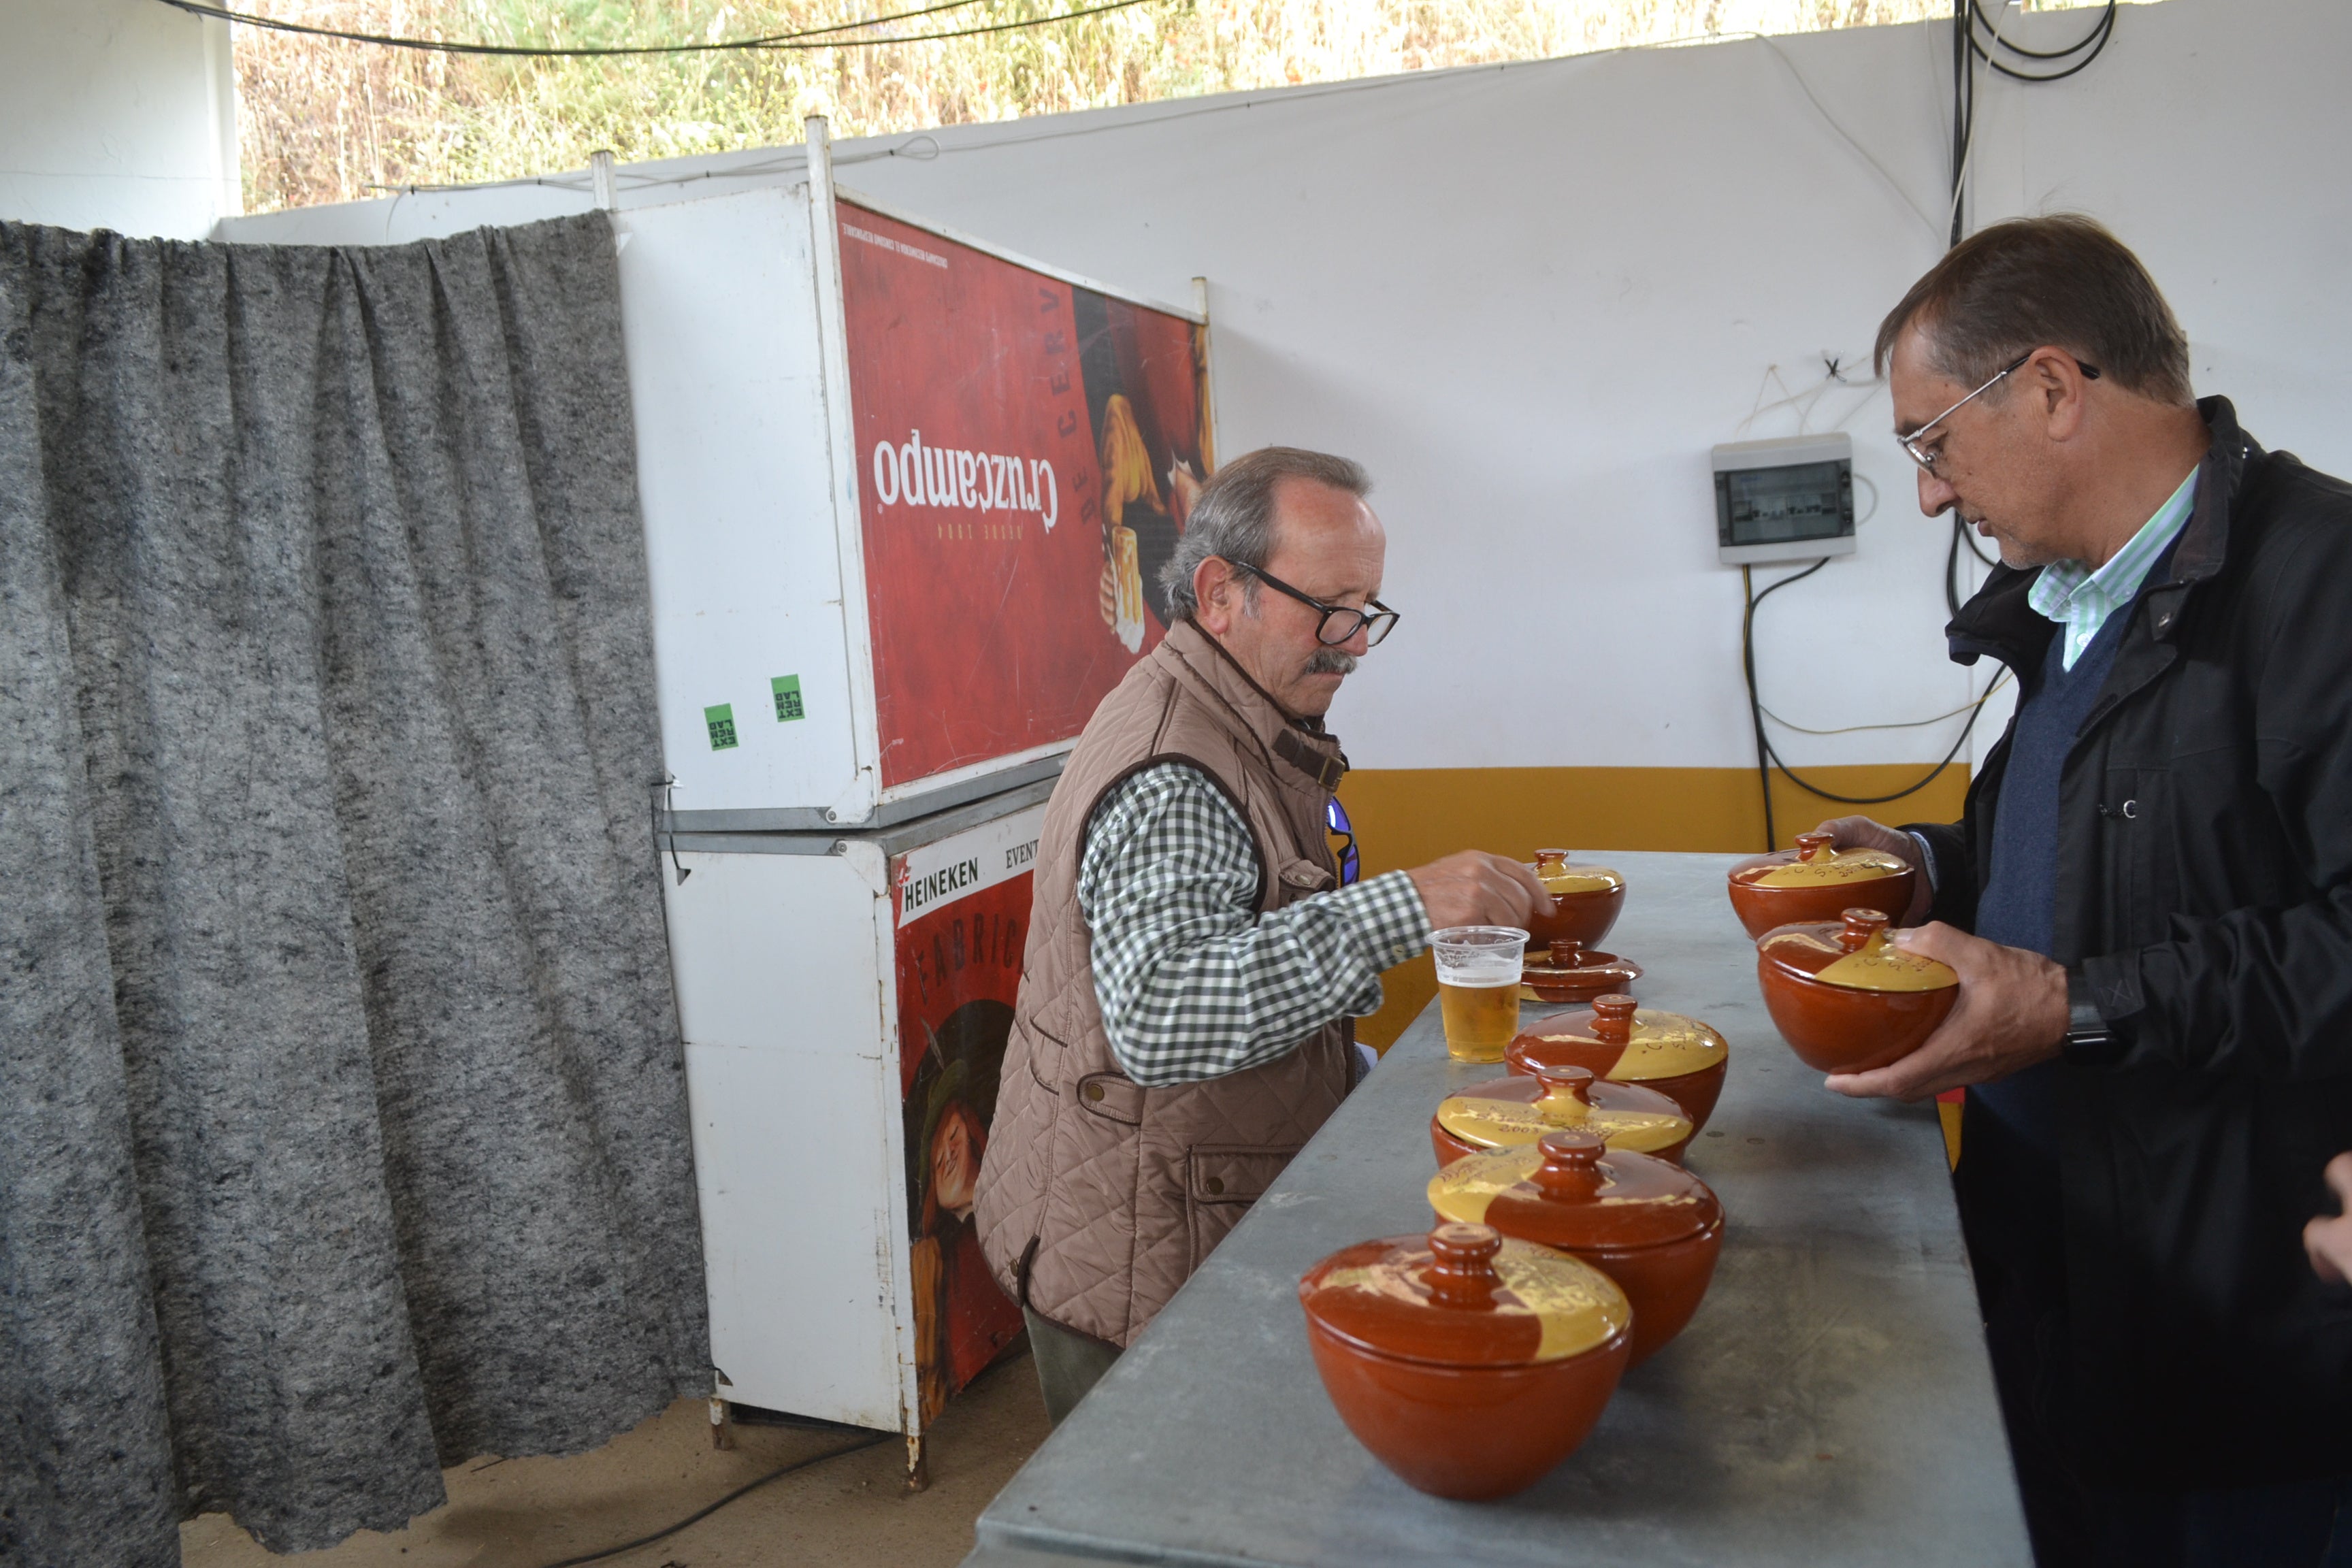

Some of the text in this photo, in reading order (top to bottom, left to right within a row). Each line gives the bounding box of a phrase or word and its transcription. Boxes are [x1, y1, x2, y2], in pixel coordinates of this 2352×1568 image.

[873, 429, 1058, 535] Cruzcampo
[774, 690, 800, 701] LAB
[777, 700, 801, 710] REM
[779, 708, 803, 719] EXT
[708, 719, 733, 730] LAB
[710, 728, 734, 738] REM
[712, 736, 736, 748] EXT
[904, 858, 979, 913] HEINEKEN
